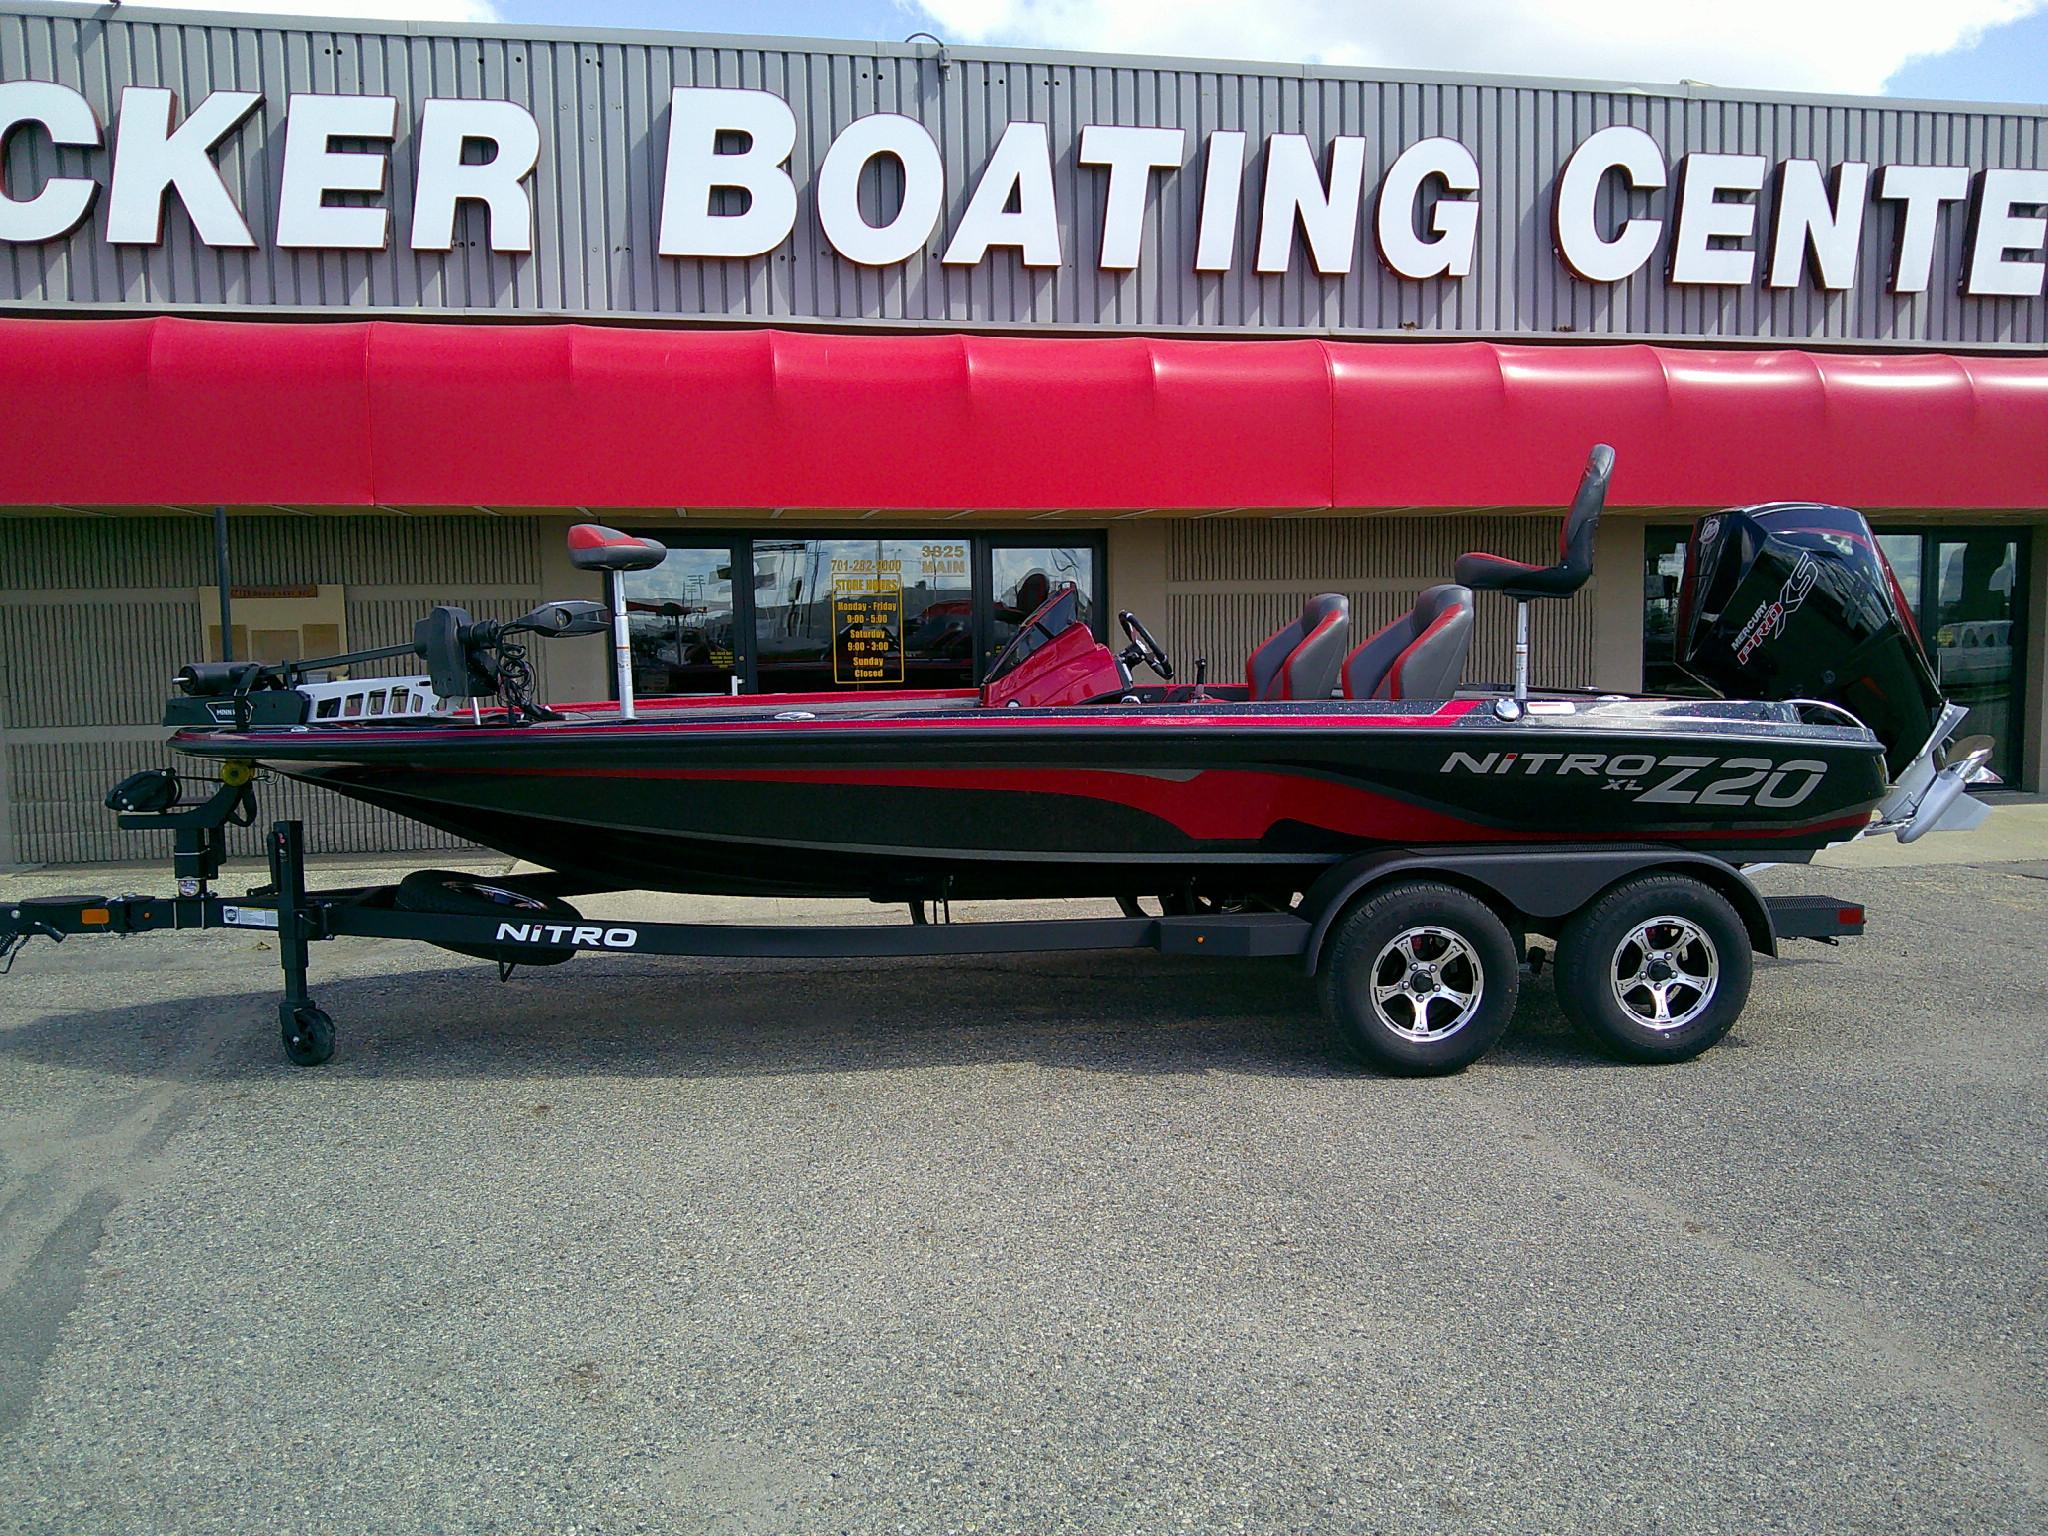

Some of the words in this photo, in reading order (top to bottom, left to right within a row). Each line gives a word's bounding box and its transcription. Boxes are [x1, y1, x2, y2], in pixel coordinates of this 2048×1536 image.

[658, 86, 1481, 279] BOATING
[921, 560, 966, 574] MAIN
[835, 579, 864, 591] STORE
[866, 579, 897, 591] HOURS
[837, 602, 867, 611] Monday
[873, 602, 897, 612] Friday
[847, 614, 865, 624] 9:00
[870, 614, 888, 624] 5:00
[1731, 600, 1768, 651] MERCURY
[850, 629, 886, 639] Saturday
[847, 641, 865, 651] 9:00
[871, 641, 889, 651] 3:00
[853, 657, 884, 667] Sunday
[854, 669, 884, 678] Closed
[1600, 778, 1643, 791] XL
[1632, 755, 1828, 808] Z20
